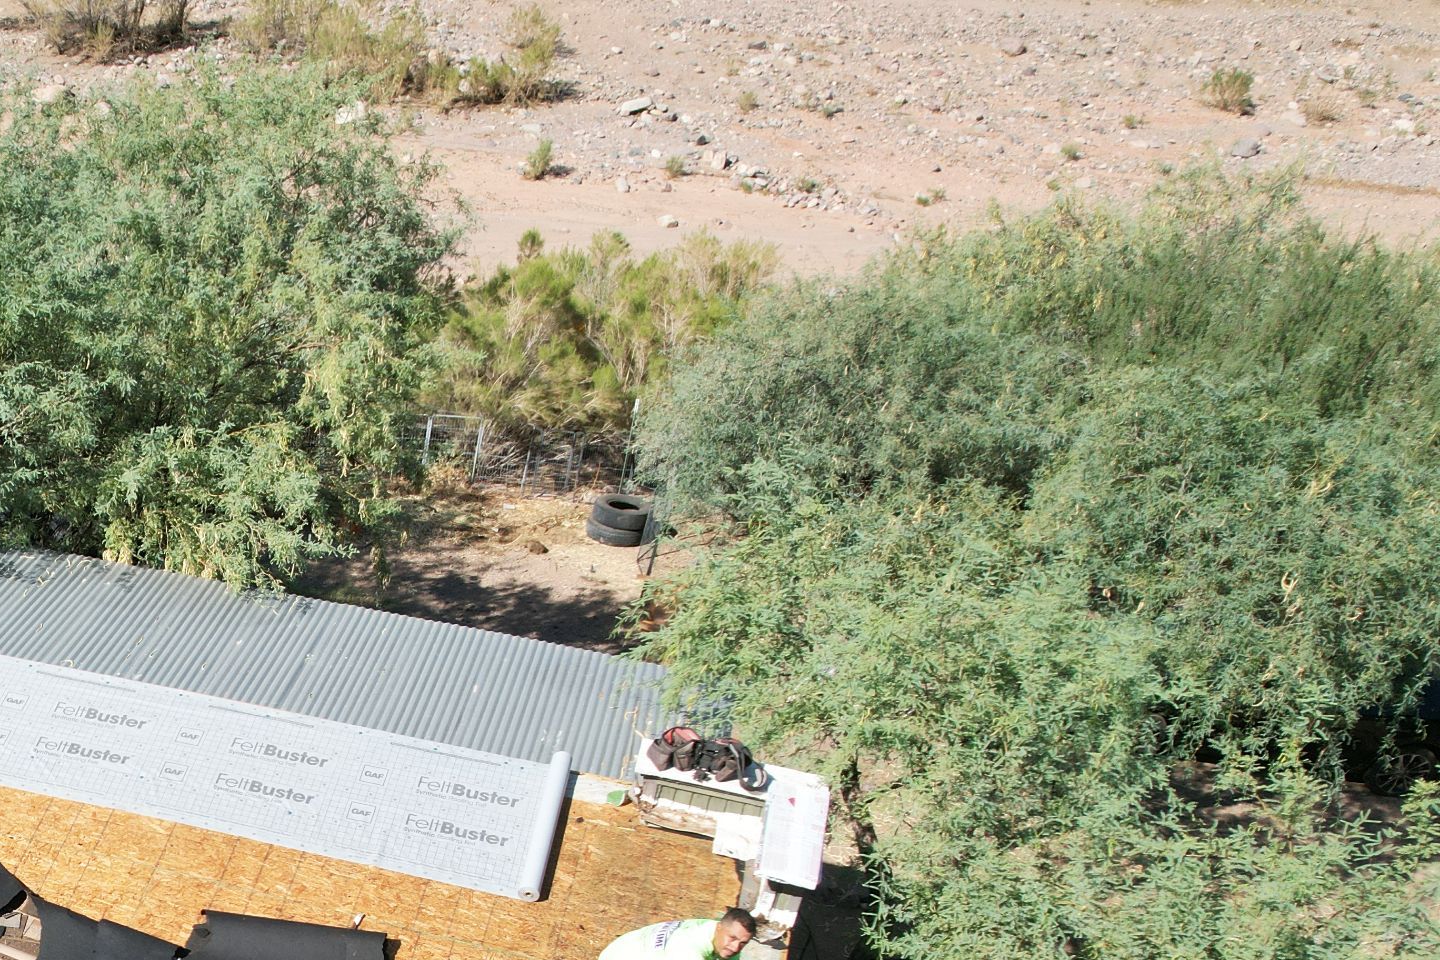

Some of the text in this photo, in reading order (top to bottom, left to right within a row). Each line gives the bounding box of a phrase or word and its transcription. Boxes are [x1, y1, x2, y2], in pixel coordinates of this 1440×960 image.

[6, 696, 25, 705] GAF
[54, 701, 147, 729] FeltBuster
[180, 731, 200, 741] GAF
[36, 736, 131, 765] FeltBuster
[231, 737, 329, 768] FeltBuster
[164, 767, 184, 777] GAF
[364, 770, 386, 780] GAF
[215, 772, 315, 805] FeltBuster
[417, 775, 520, 808] FeltBuster
[351, 807, 372, 817] GAF
[405, 813, 509, 847] FeltBuster
